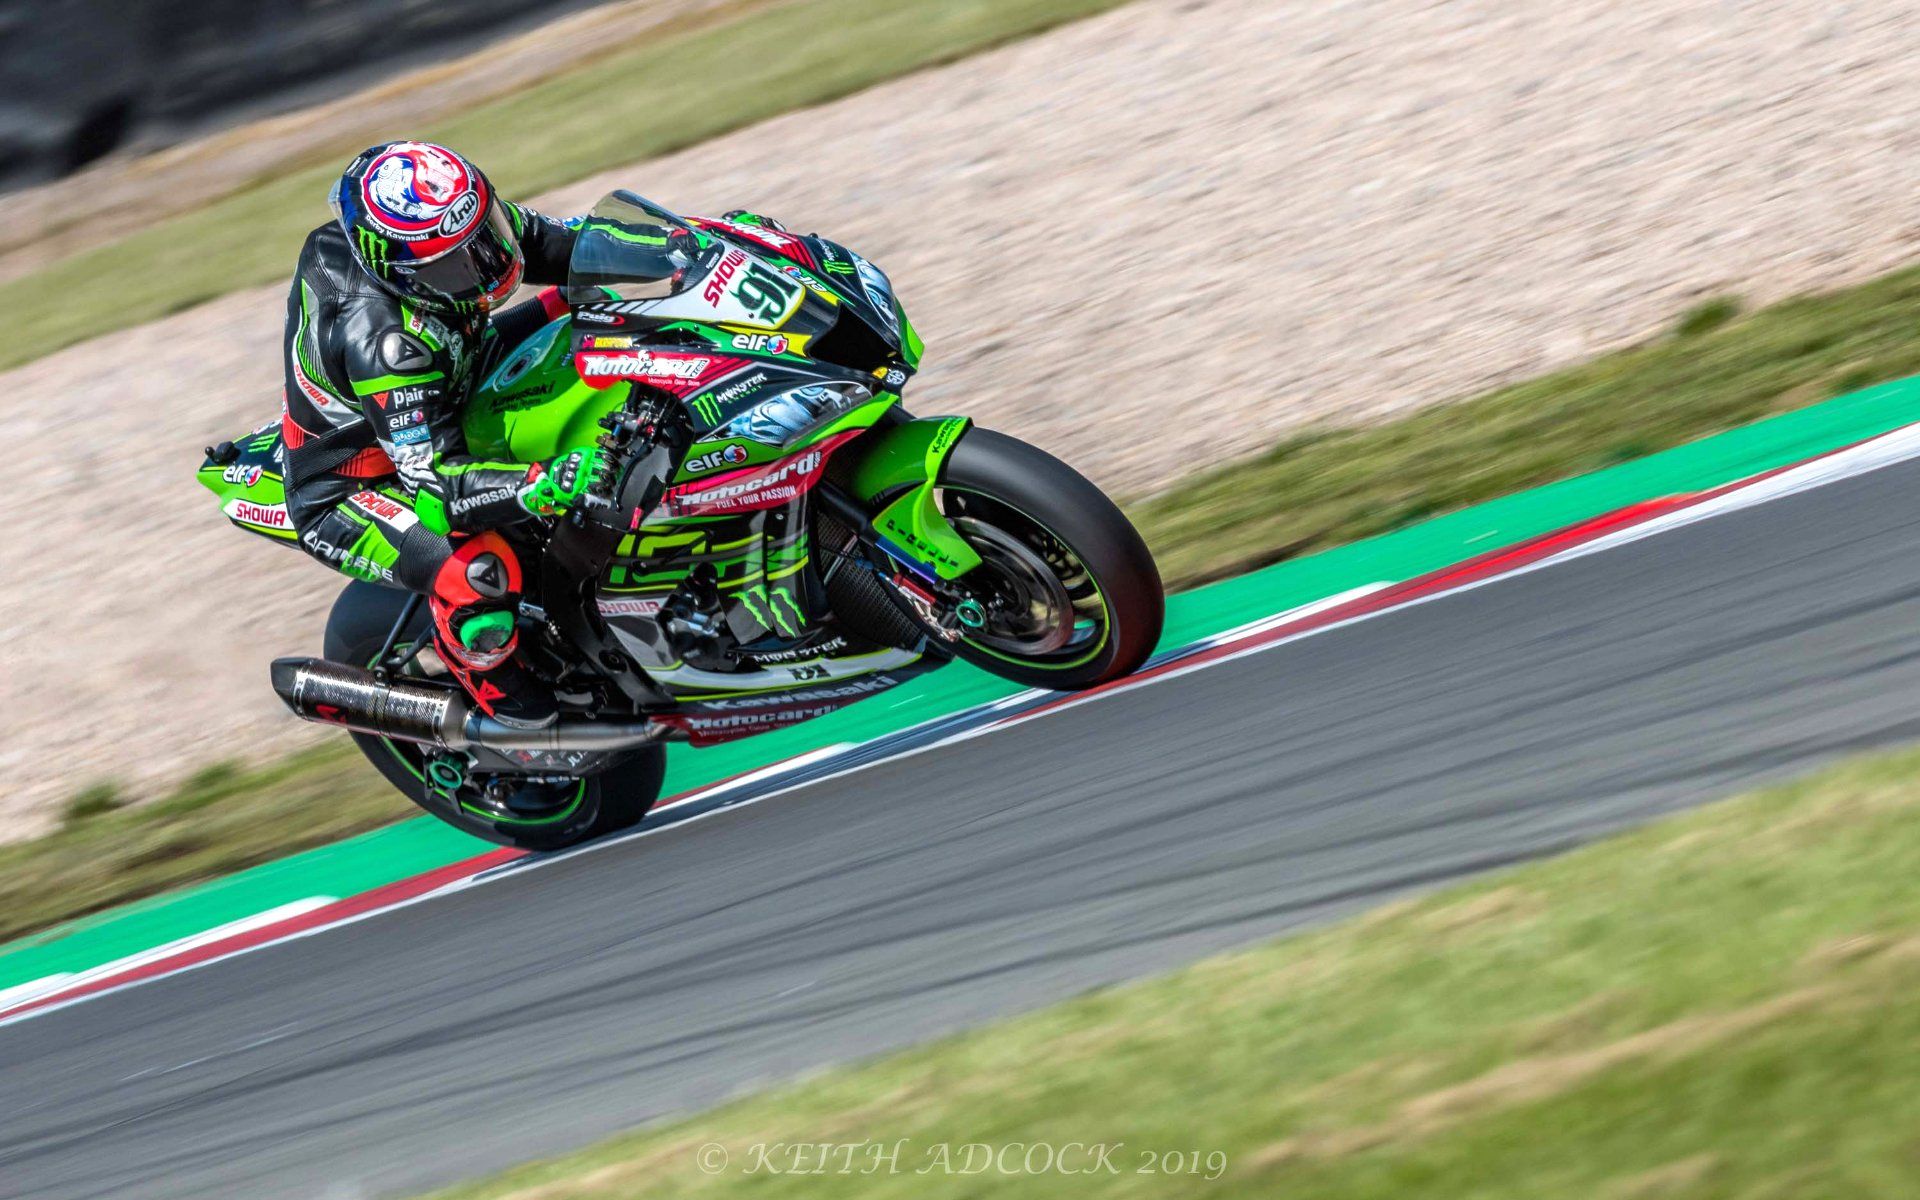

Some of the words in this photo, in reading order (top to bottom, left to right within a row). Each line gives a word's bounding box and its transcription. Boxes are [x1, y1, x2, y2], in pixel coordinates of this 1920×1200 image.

[446, 193, 476, 233] Arai
[366, 214, 387, 234] Derby
[386, 230, 430, 242] Kawasaki
[703, 249, 750, 309] SHOWA
[729, 261, 799, 325] 91
[577, 311, 616, 324] Puig
[732, 334, 768, 351] elf
[294, 364, 330, 406] SHOWA
[716, 372, 768, 404] MONSTER
[390, 413, 411, 428] elf
[223, 465, 249, 483] elf
[686, 451, 723, 472] elf
[716, 500, 737, 509] FUEL
[738, 495, 760, 505] YOUR
[761, 485, 797, 501] PASSION
[236, 503, 287, 526] SHOWA
[886, 519, 959, 567] PIRELLI
[753, 636, 848, 662] MONSTER
